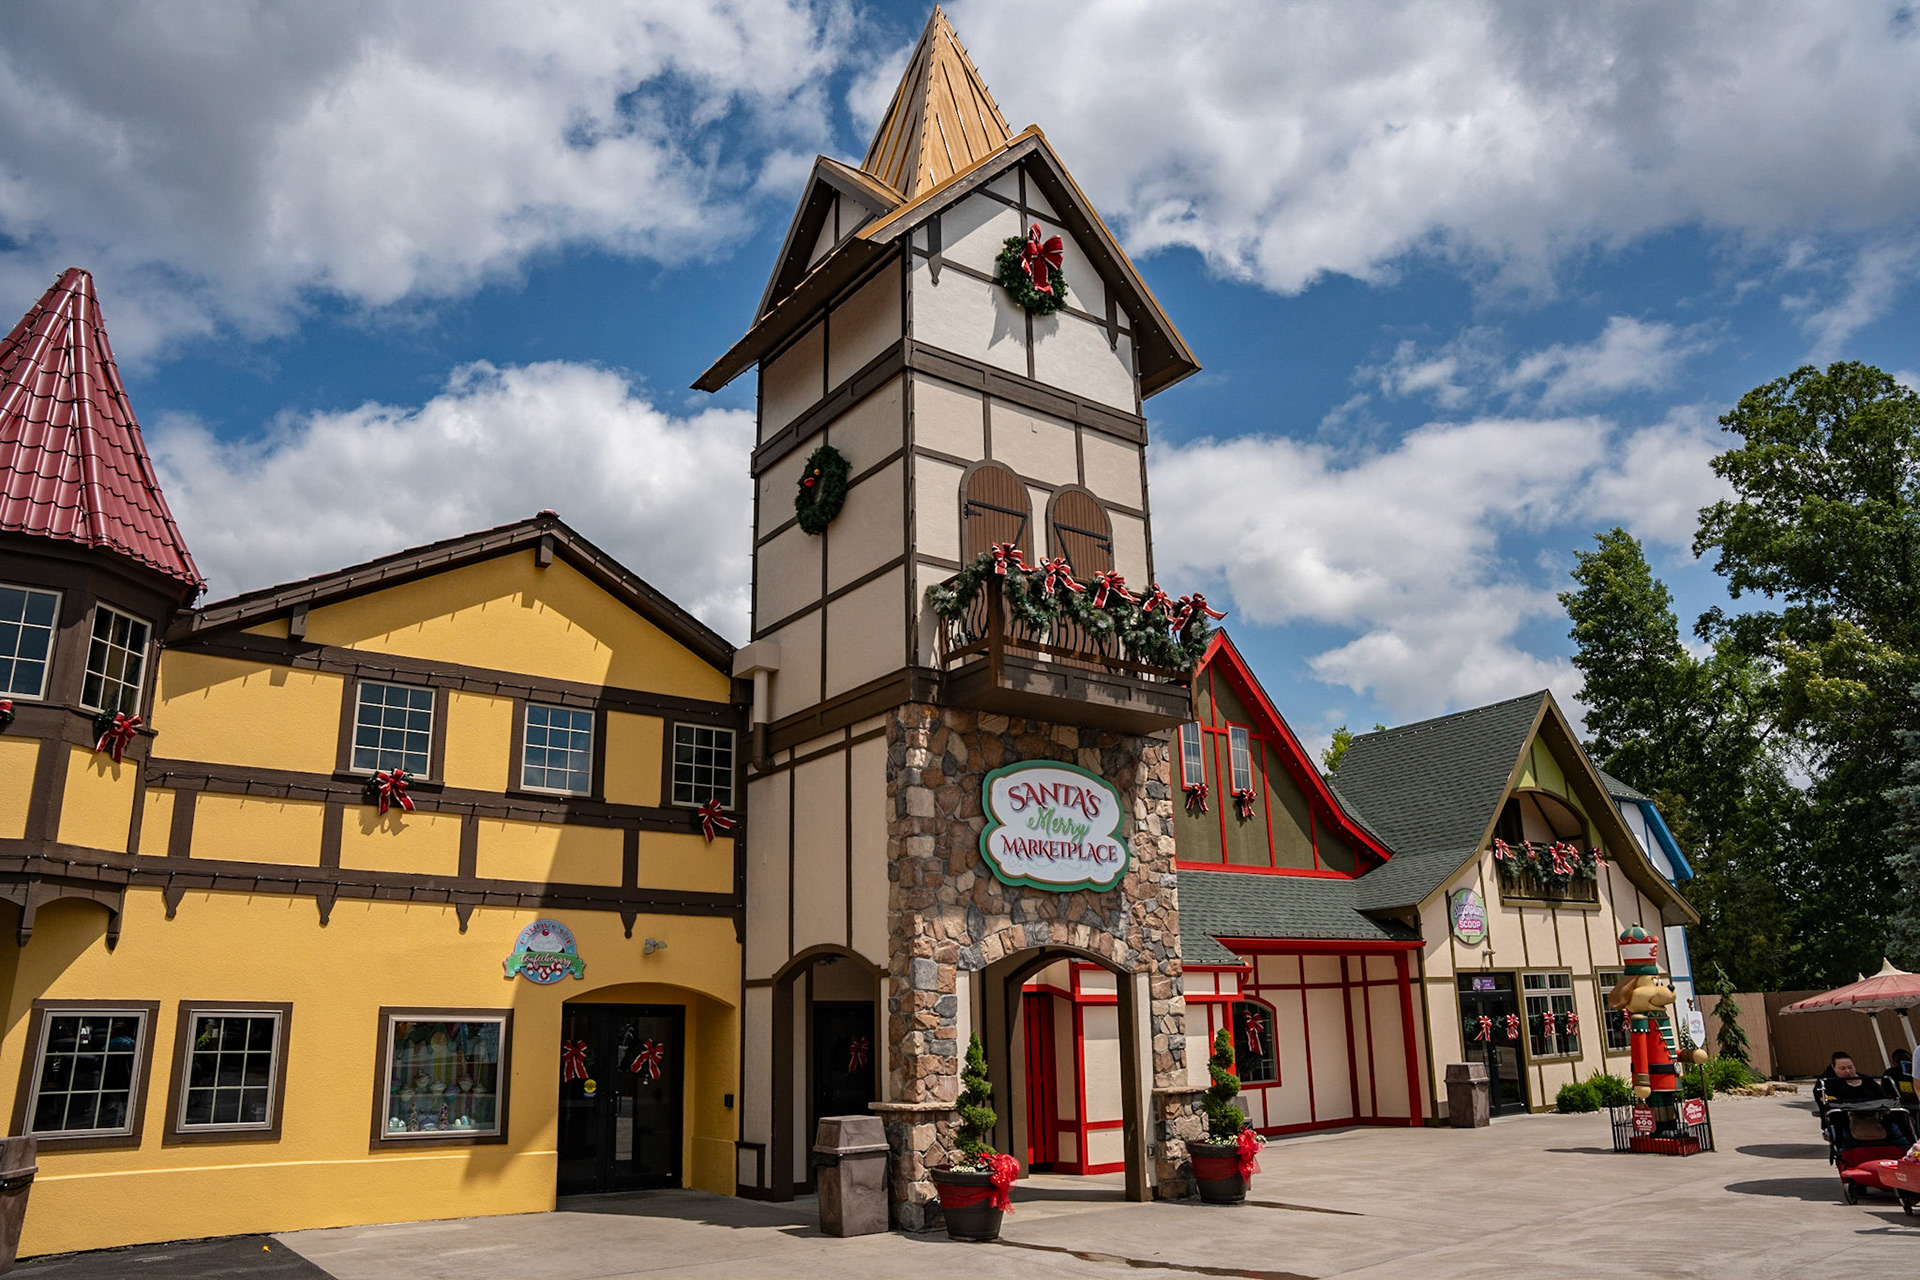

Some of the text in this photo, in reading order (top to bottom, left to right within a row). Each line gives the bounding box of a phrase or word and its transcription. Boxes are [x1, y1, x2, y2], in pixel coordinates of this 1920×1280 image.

[1008, 782, 1101, 820] SANTA'S
[1027, 807, 1090, 844] Merry
[1001, 834, 1118, 865] MARKETPLACE
[1459, 920, 1481, 929] SCOOP
